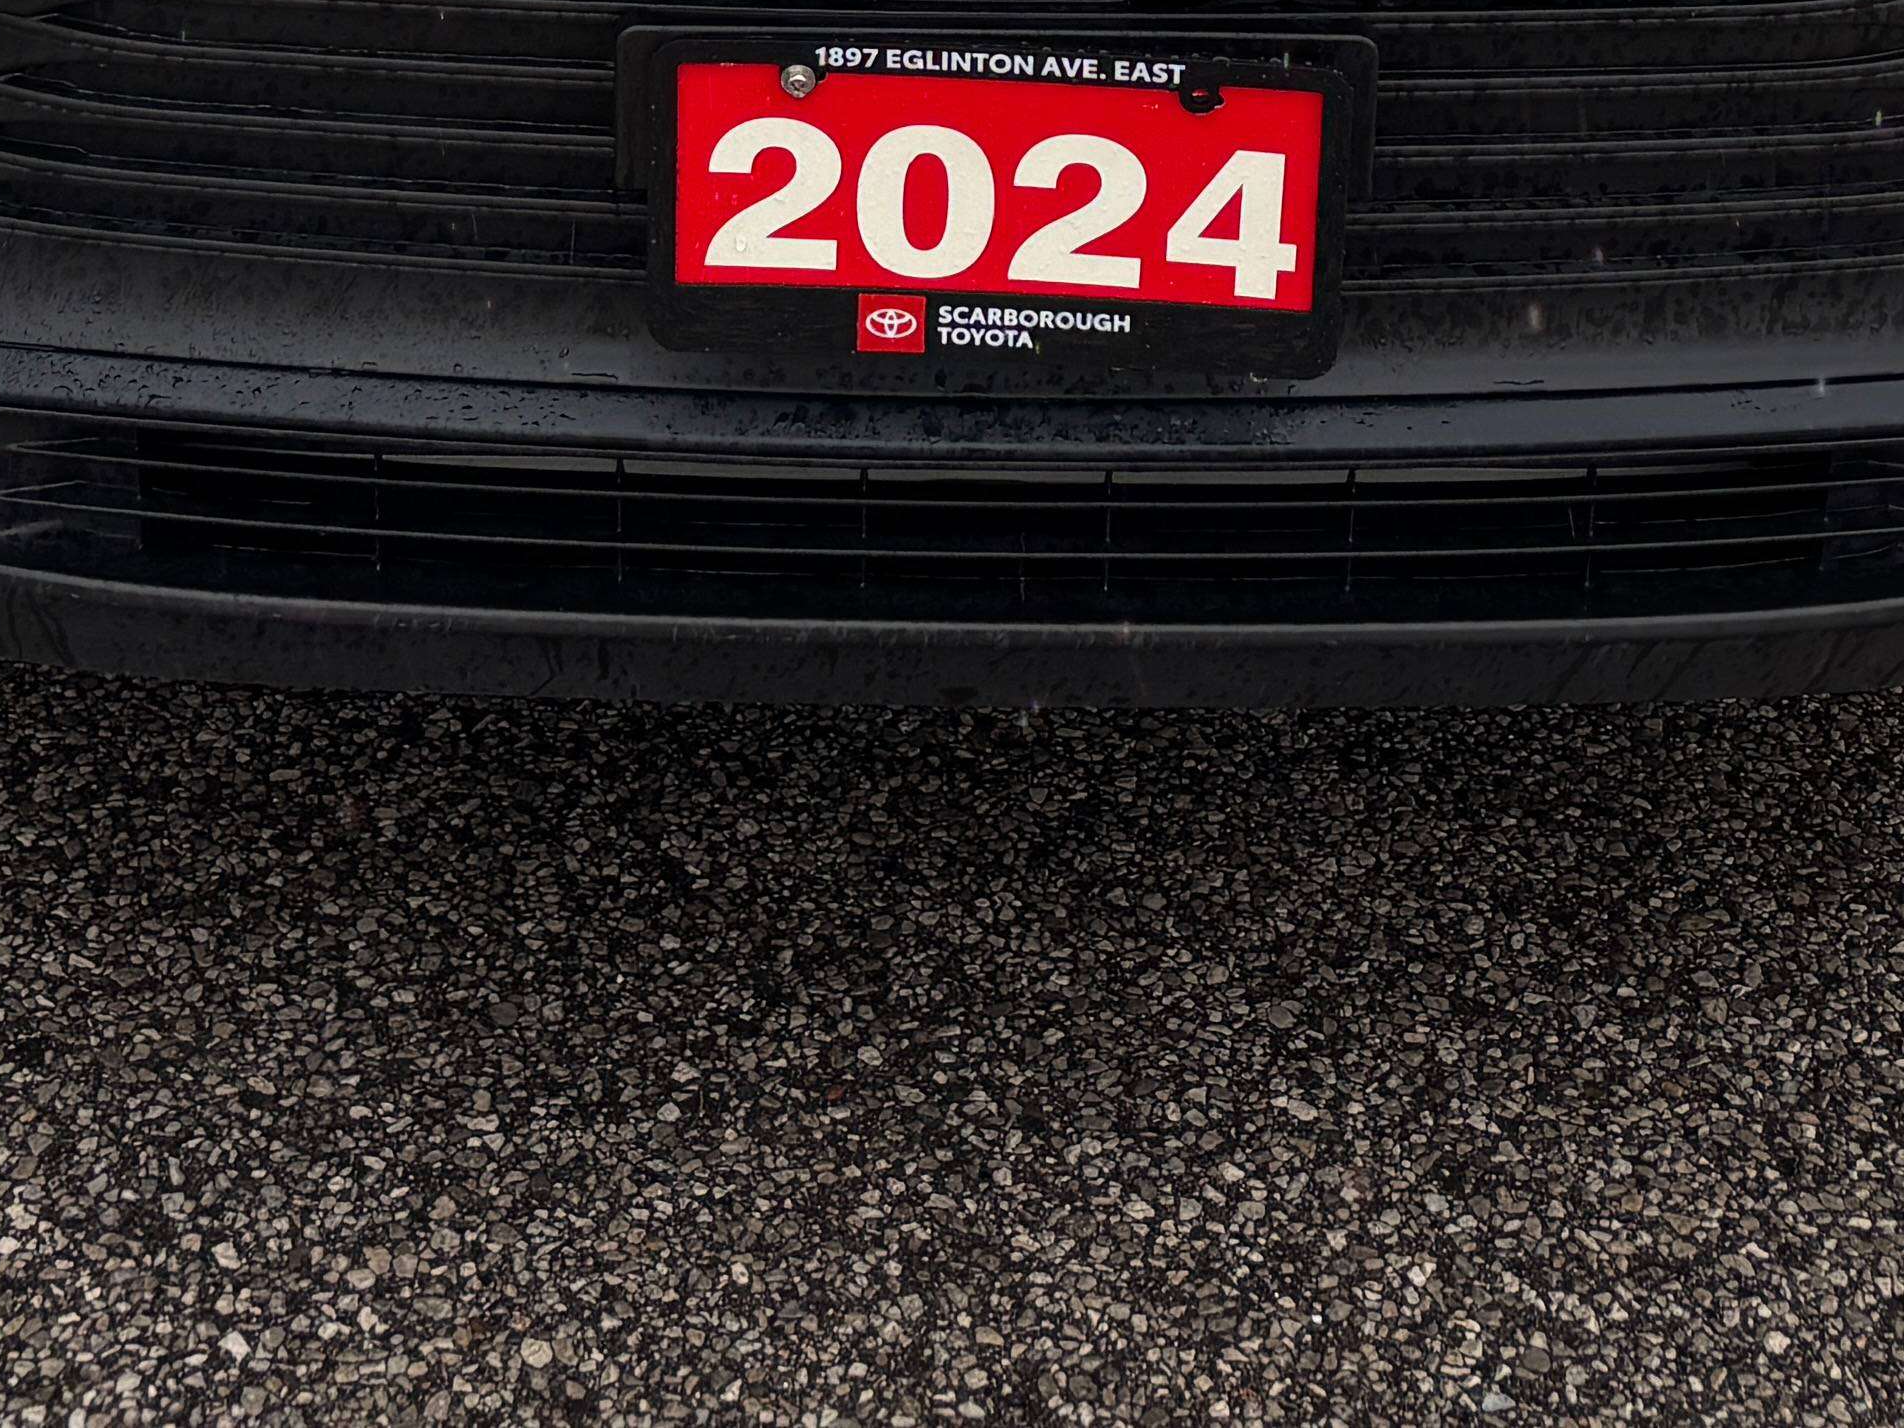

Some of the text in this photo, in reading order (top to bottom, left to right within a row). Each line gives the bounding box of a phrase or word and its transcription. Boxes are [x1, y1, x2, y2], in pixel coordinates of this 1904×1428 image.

[815, 46, 1186, 85] 1897 EGLINTON AVE. EAST
[703, 116, 1298, 299] 2024
[938, 305, 1131, 333] SCARBOROUGH
[937, 326, 1034, 350] TOYOTA
